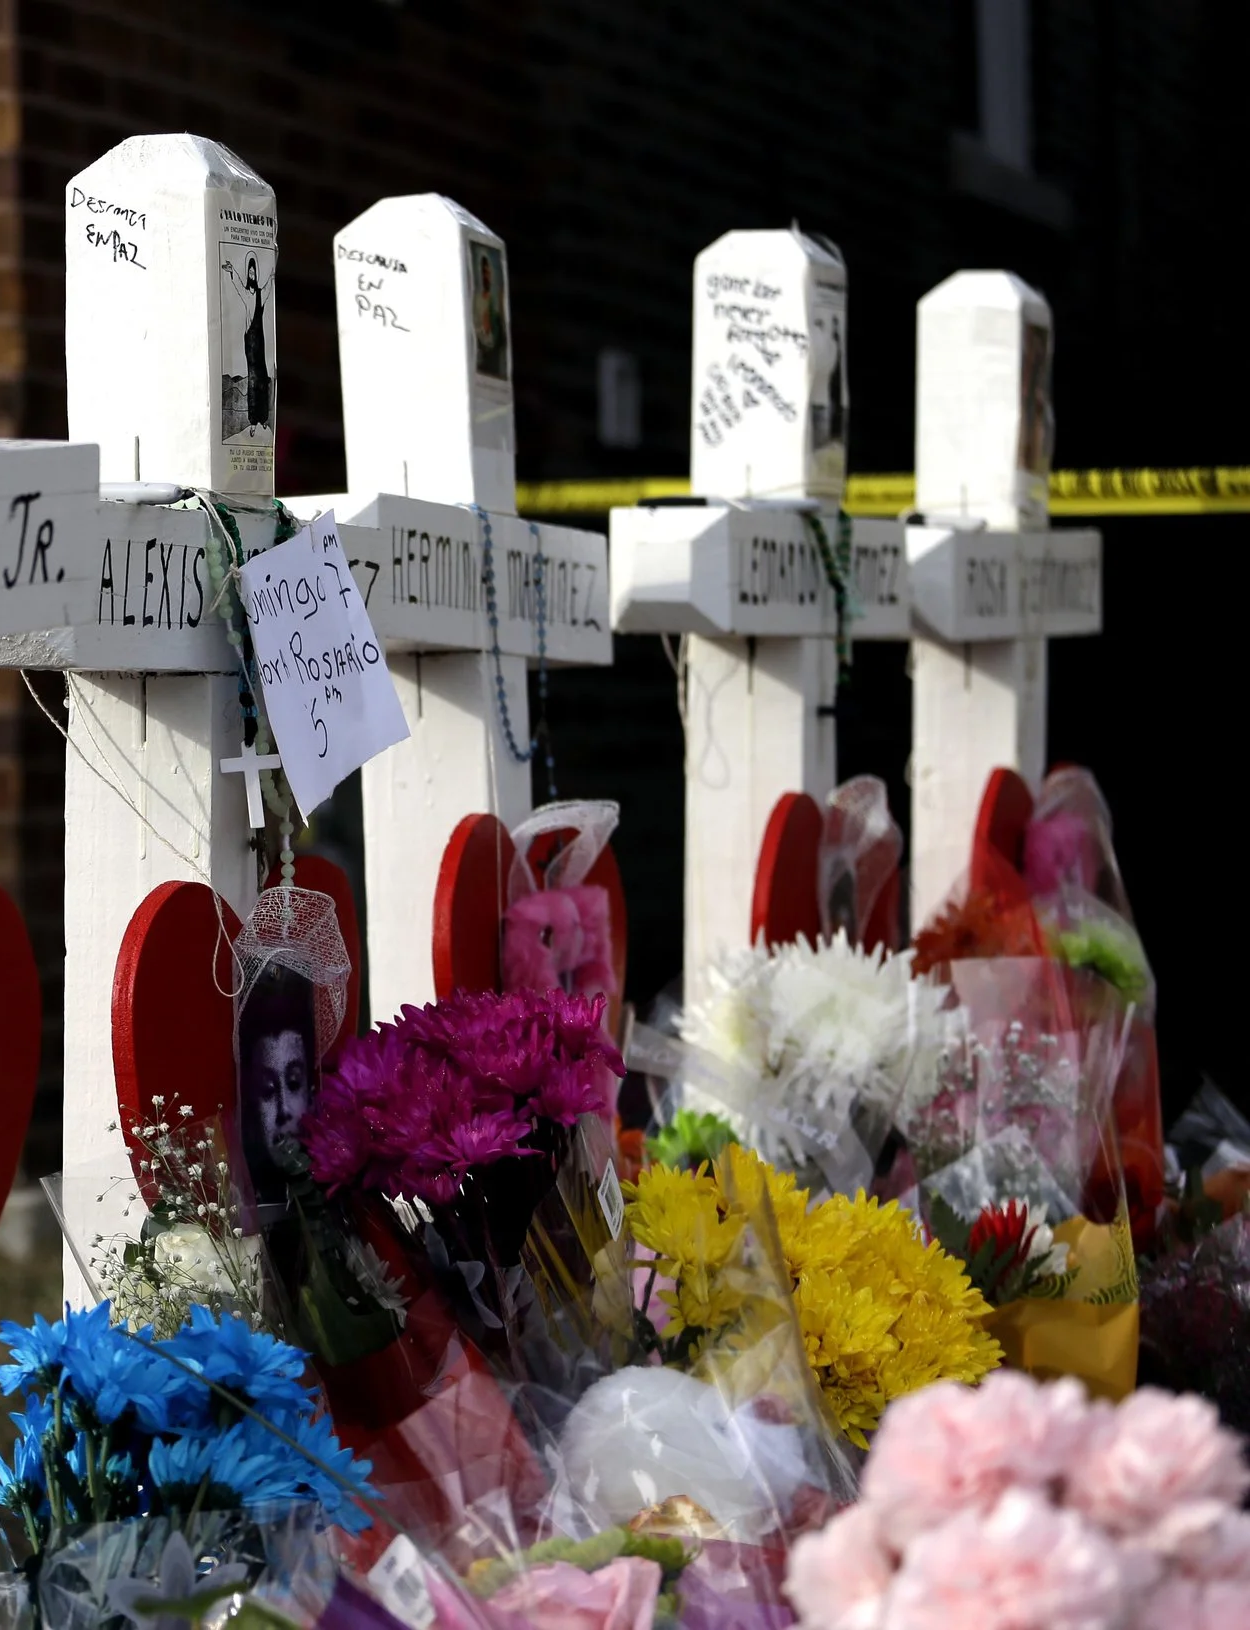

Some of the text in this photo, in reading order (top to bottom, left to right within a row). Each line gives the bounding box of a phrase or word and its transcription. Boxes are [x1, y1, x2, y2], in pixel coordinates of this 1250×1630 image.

[242, 212, 265, 226] TIENES
[86, 223, 147, 270] EN PAZ
[357, 273, 385, 292] EN
[354, 293, 411, 333] PAZ
[98, 537, 206, 631] ALEXIS
[310, 697, 328, 758] 5
